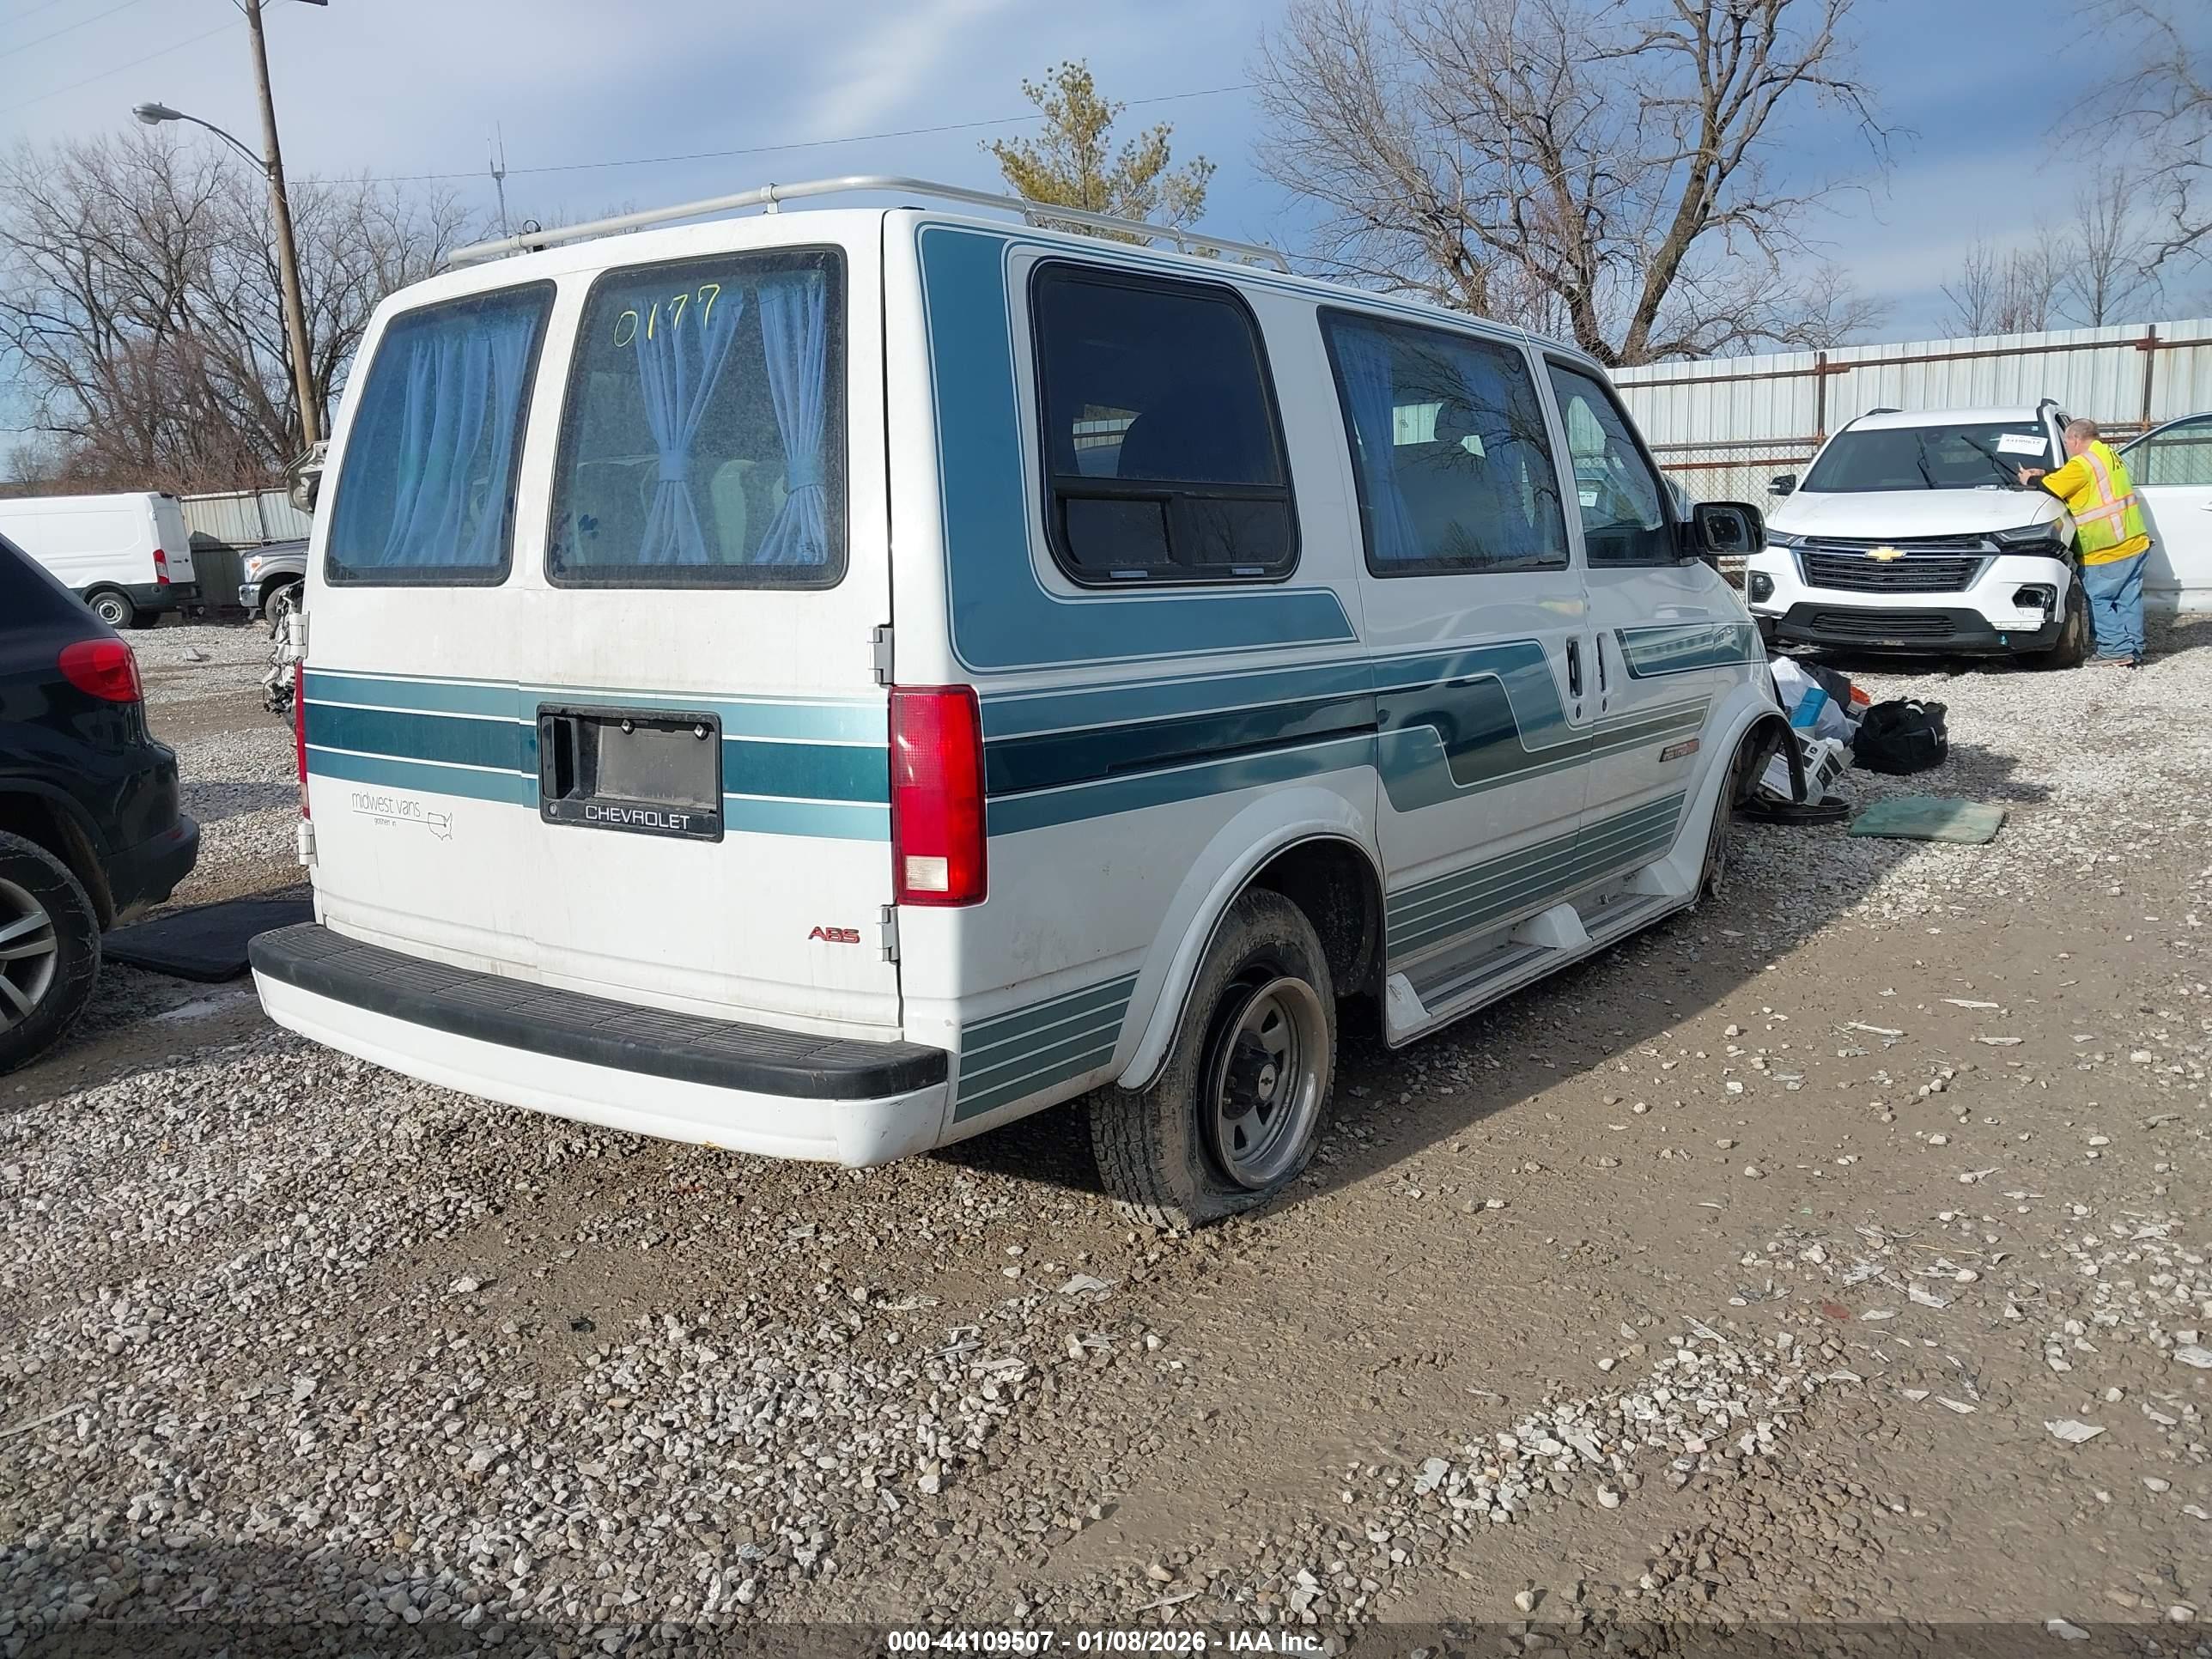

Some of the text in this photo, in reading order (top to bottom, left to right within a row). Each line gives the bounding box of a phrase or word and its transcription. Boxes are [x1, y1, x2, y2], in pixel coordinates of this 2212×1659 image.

[614, 283, 720, 347] 0177
[351, 791, 421, 817] midwest vans
[585, 805, 690, 830] CHEVROLET
[808, 926, 860, 944] ABS
